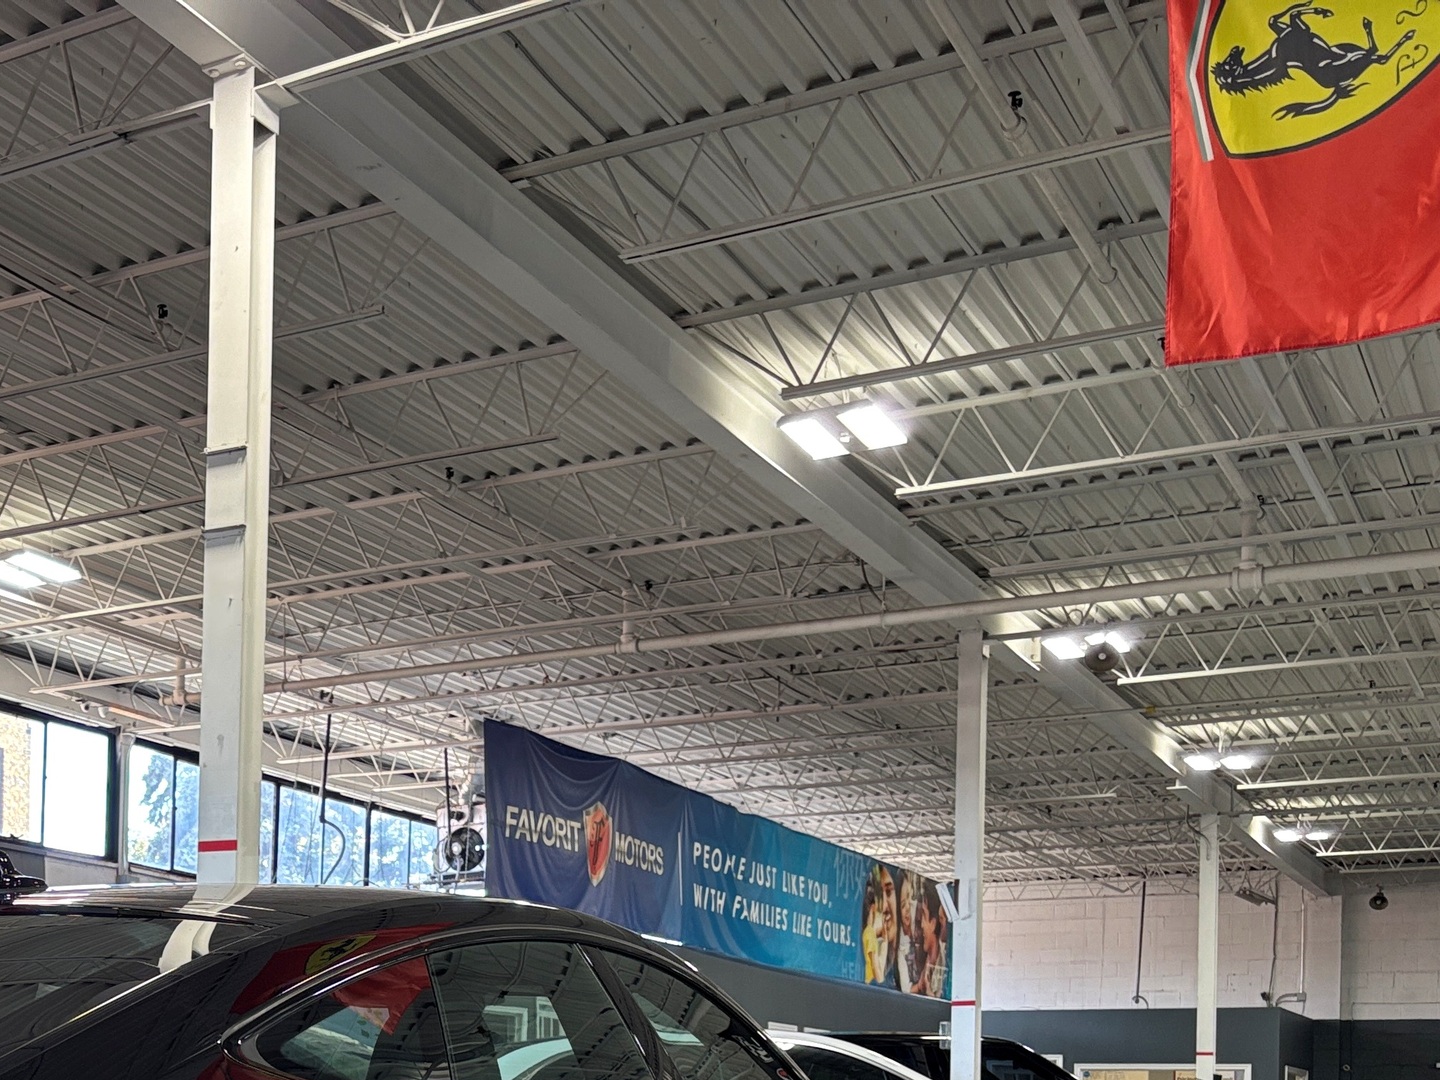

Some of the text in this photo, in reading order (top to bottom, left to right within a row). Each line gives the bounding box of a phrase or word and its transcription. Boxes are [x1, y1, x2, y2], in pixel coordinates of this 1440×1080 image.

[505, 805, 581, 852] FAVORIT
[615, 831, 664, 876] MOTORS
[693, 883, 856, 948] WITH FAMILIES LIKE YOURS.
[748, 861, 777, 890] JUST
[782, 870, 805, 898] LIKE
[808, 878, 833, 908] YOU,
